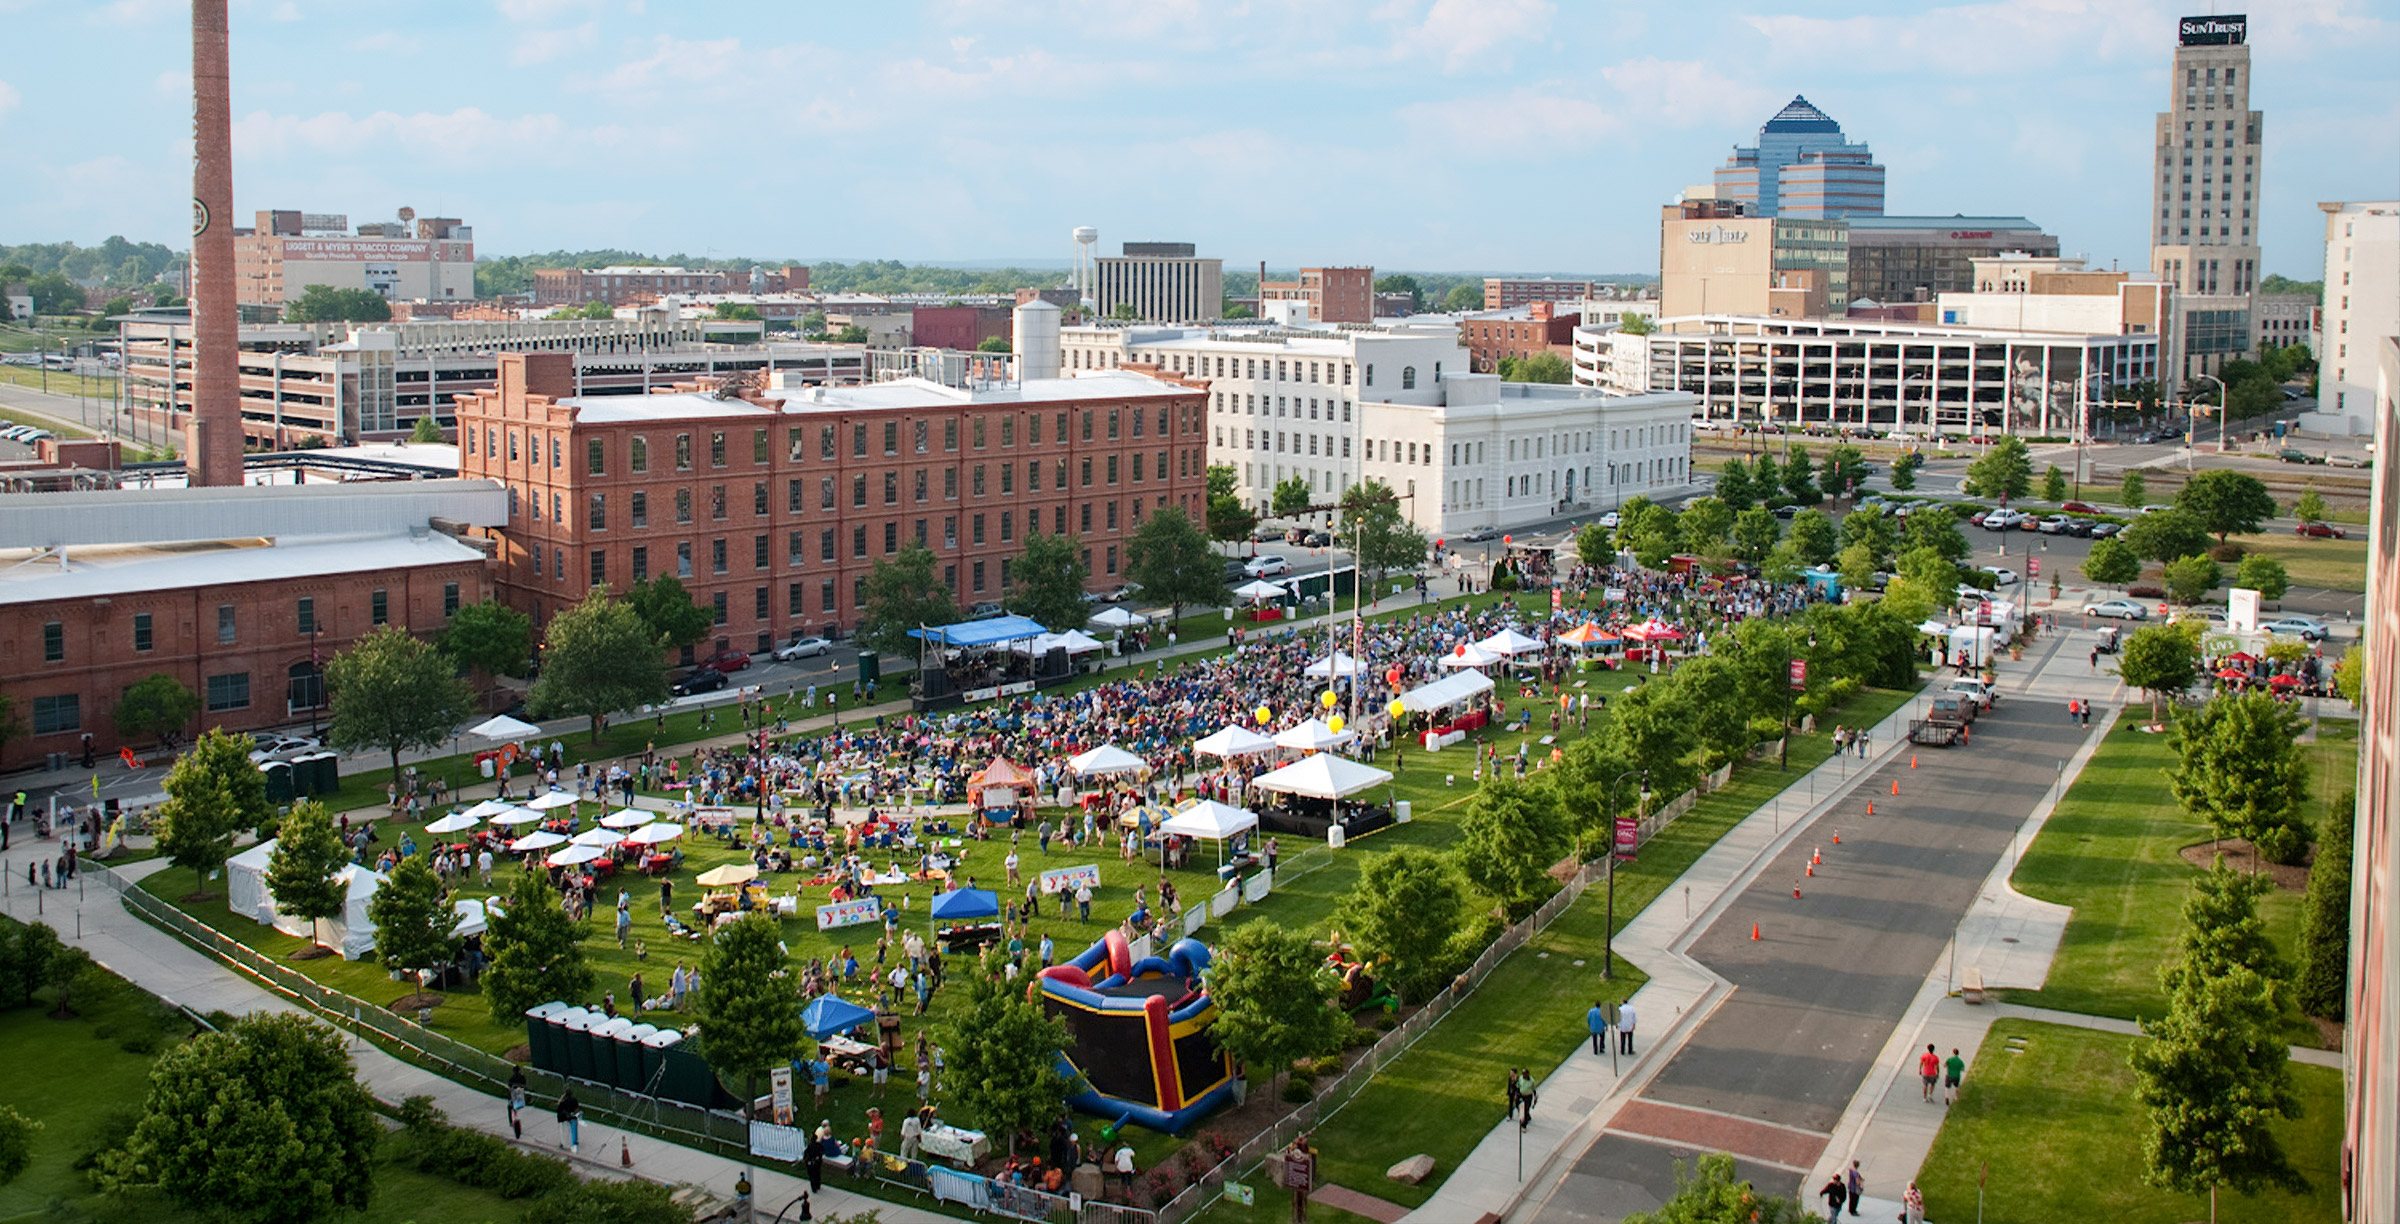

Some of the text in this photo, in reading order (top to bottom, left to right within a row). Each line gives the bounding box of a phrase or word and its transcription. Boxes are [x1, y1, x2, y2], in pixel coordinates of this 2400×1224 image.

[286, 242, 316, 251] LIGGETT
[325, 243, 350, 251] MYERS
[353, 243, 387, 252] TOBACCO
[390, 243, 427, 253] COMPANY
